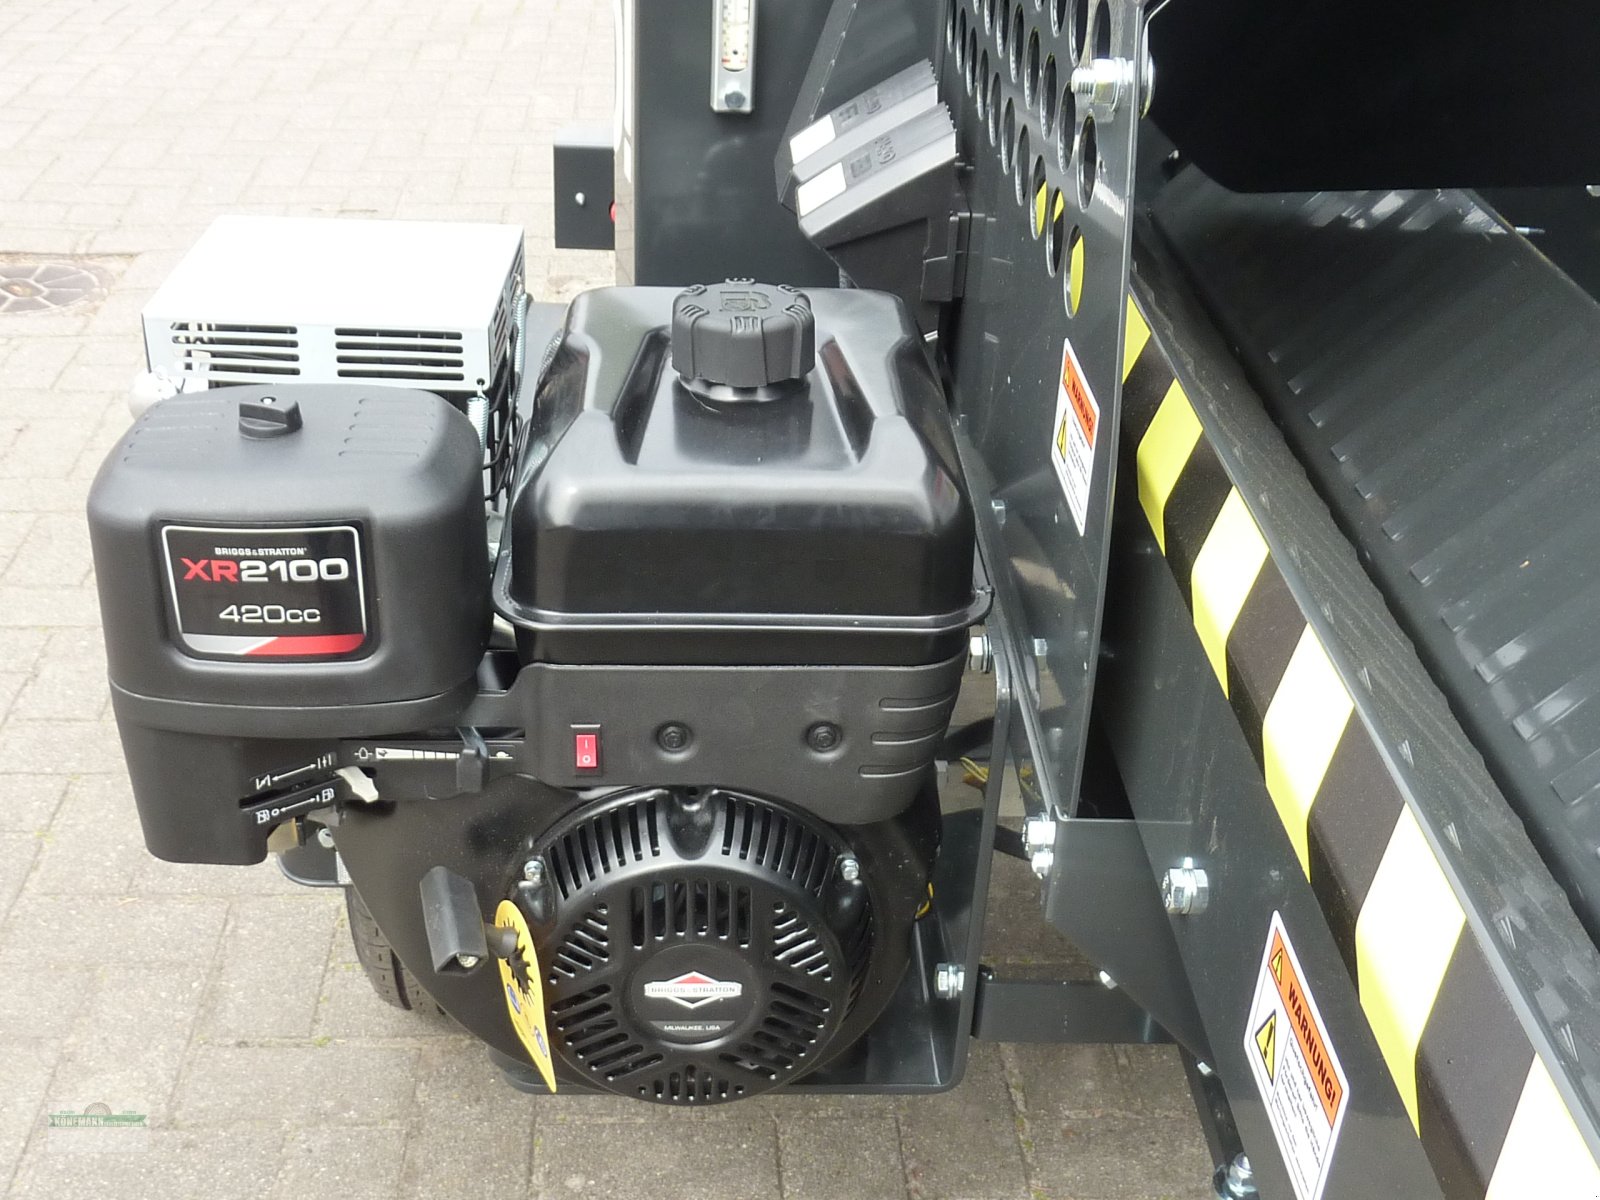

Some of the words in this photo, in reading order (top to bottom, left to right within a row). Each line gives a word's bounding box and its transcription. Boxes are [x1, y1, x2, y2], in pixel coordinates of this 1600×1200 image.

[180, 557, 349, 582] XR2100
[218, 604, 321, 624] 420cc
[1288, 981, 1336, 1108] WARNUNG!
